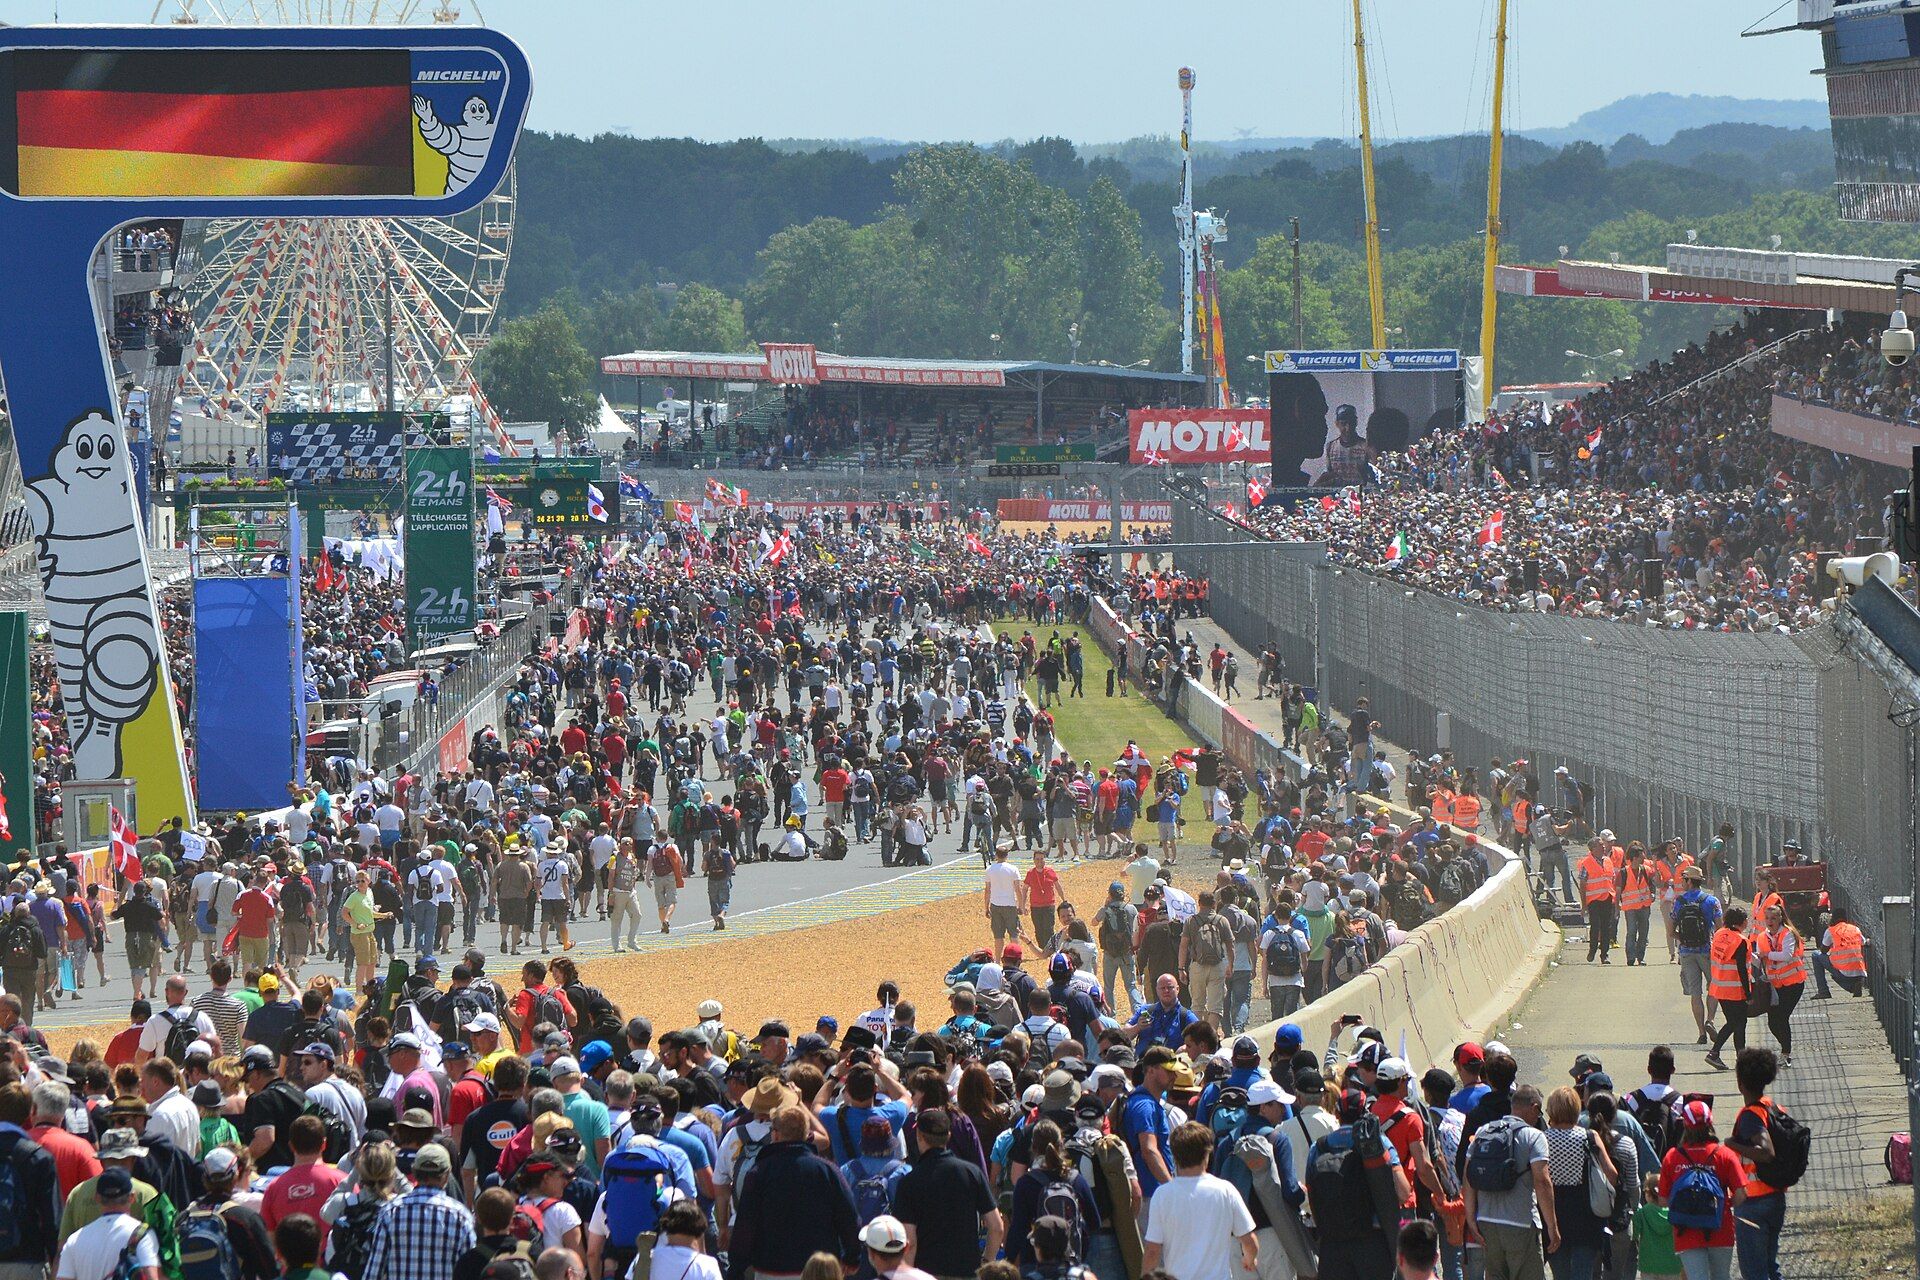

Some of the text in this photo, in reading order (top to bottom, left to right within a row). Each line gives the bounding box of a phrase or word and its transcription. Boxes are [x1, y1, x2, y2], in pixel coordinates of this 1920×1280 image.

[417, 71, 501, 81] MICHELIN
[770, 350, 816, 378] MOTUL
[1298, 356, 1356, 364] MICHELIN
[1393, 355, 1453, 364] MICHELIN
[350, 424, 377, 438] 24h
[1136, 420, 1271, 452] MOTUL
[413, 470, 466, 498] 24h
[411, 513, 467, 522] TÉLÉCHARGEZ
[1048, 504, 1091, 519] MOTUL
[1096, 505, 1134, 520] MOUL
[1139, 505, 1172, 521] MOTU
[411, 523, 468, 531] L'APPLICATION
[415, 587, 469, 615] 24h
[413, 615, 466, 624] LE MANS
[543, 867, 558, 881] 20
[489, 1130, 515, 1140] Gulf
